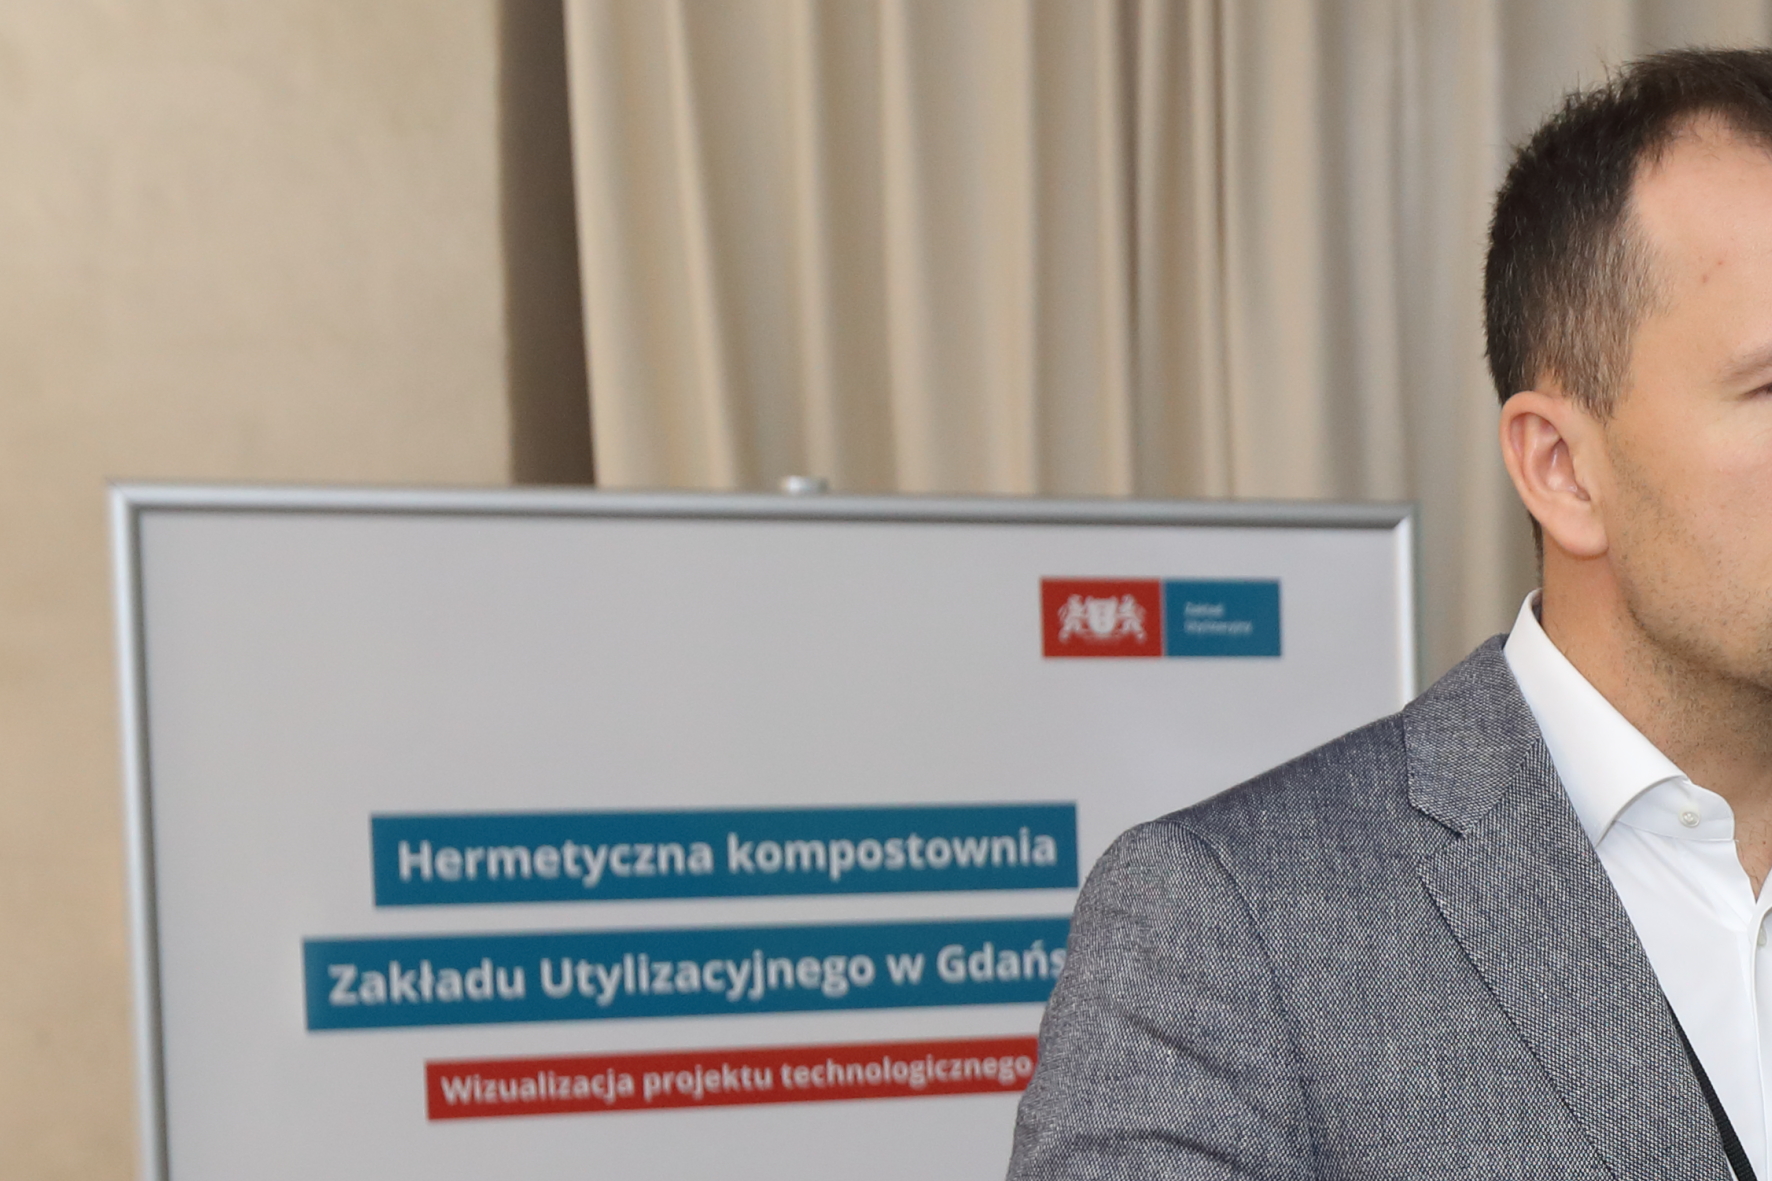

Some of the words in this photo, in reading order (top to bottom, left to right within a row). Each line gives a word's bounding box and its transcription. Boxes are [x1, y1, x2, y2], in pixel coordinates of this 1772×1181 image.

[398, 838, 715, 888] Hermetyczna
[726, 826, 1058, 882] kompostownia
[327, 957, 526, 1007] Zakładu
[539, 949, 876, 1007] Utylizacyjnego
[885, 949, 926, 984] w
[935, 939, 1066, 985] Gdańs
[440, 1068, 635, 1106] Wizualizacja
[642, 1062, 774, 1102] projektu
[780, 1054, 1034, 1090] technologicznego
